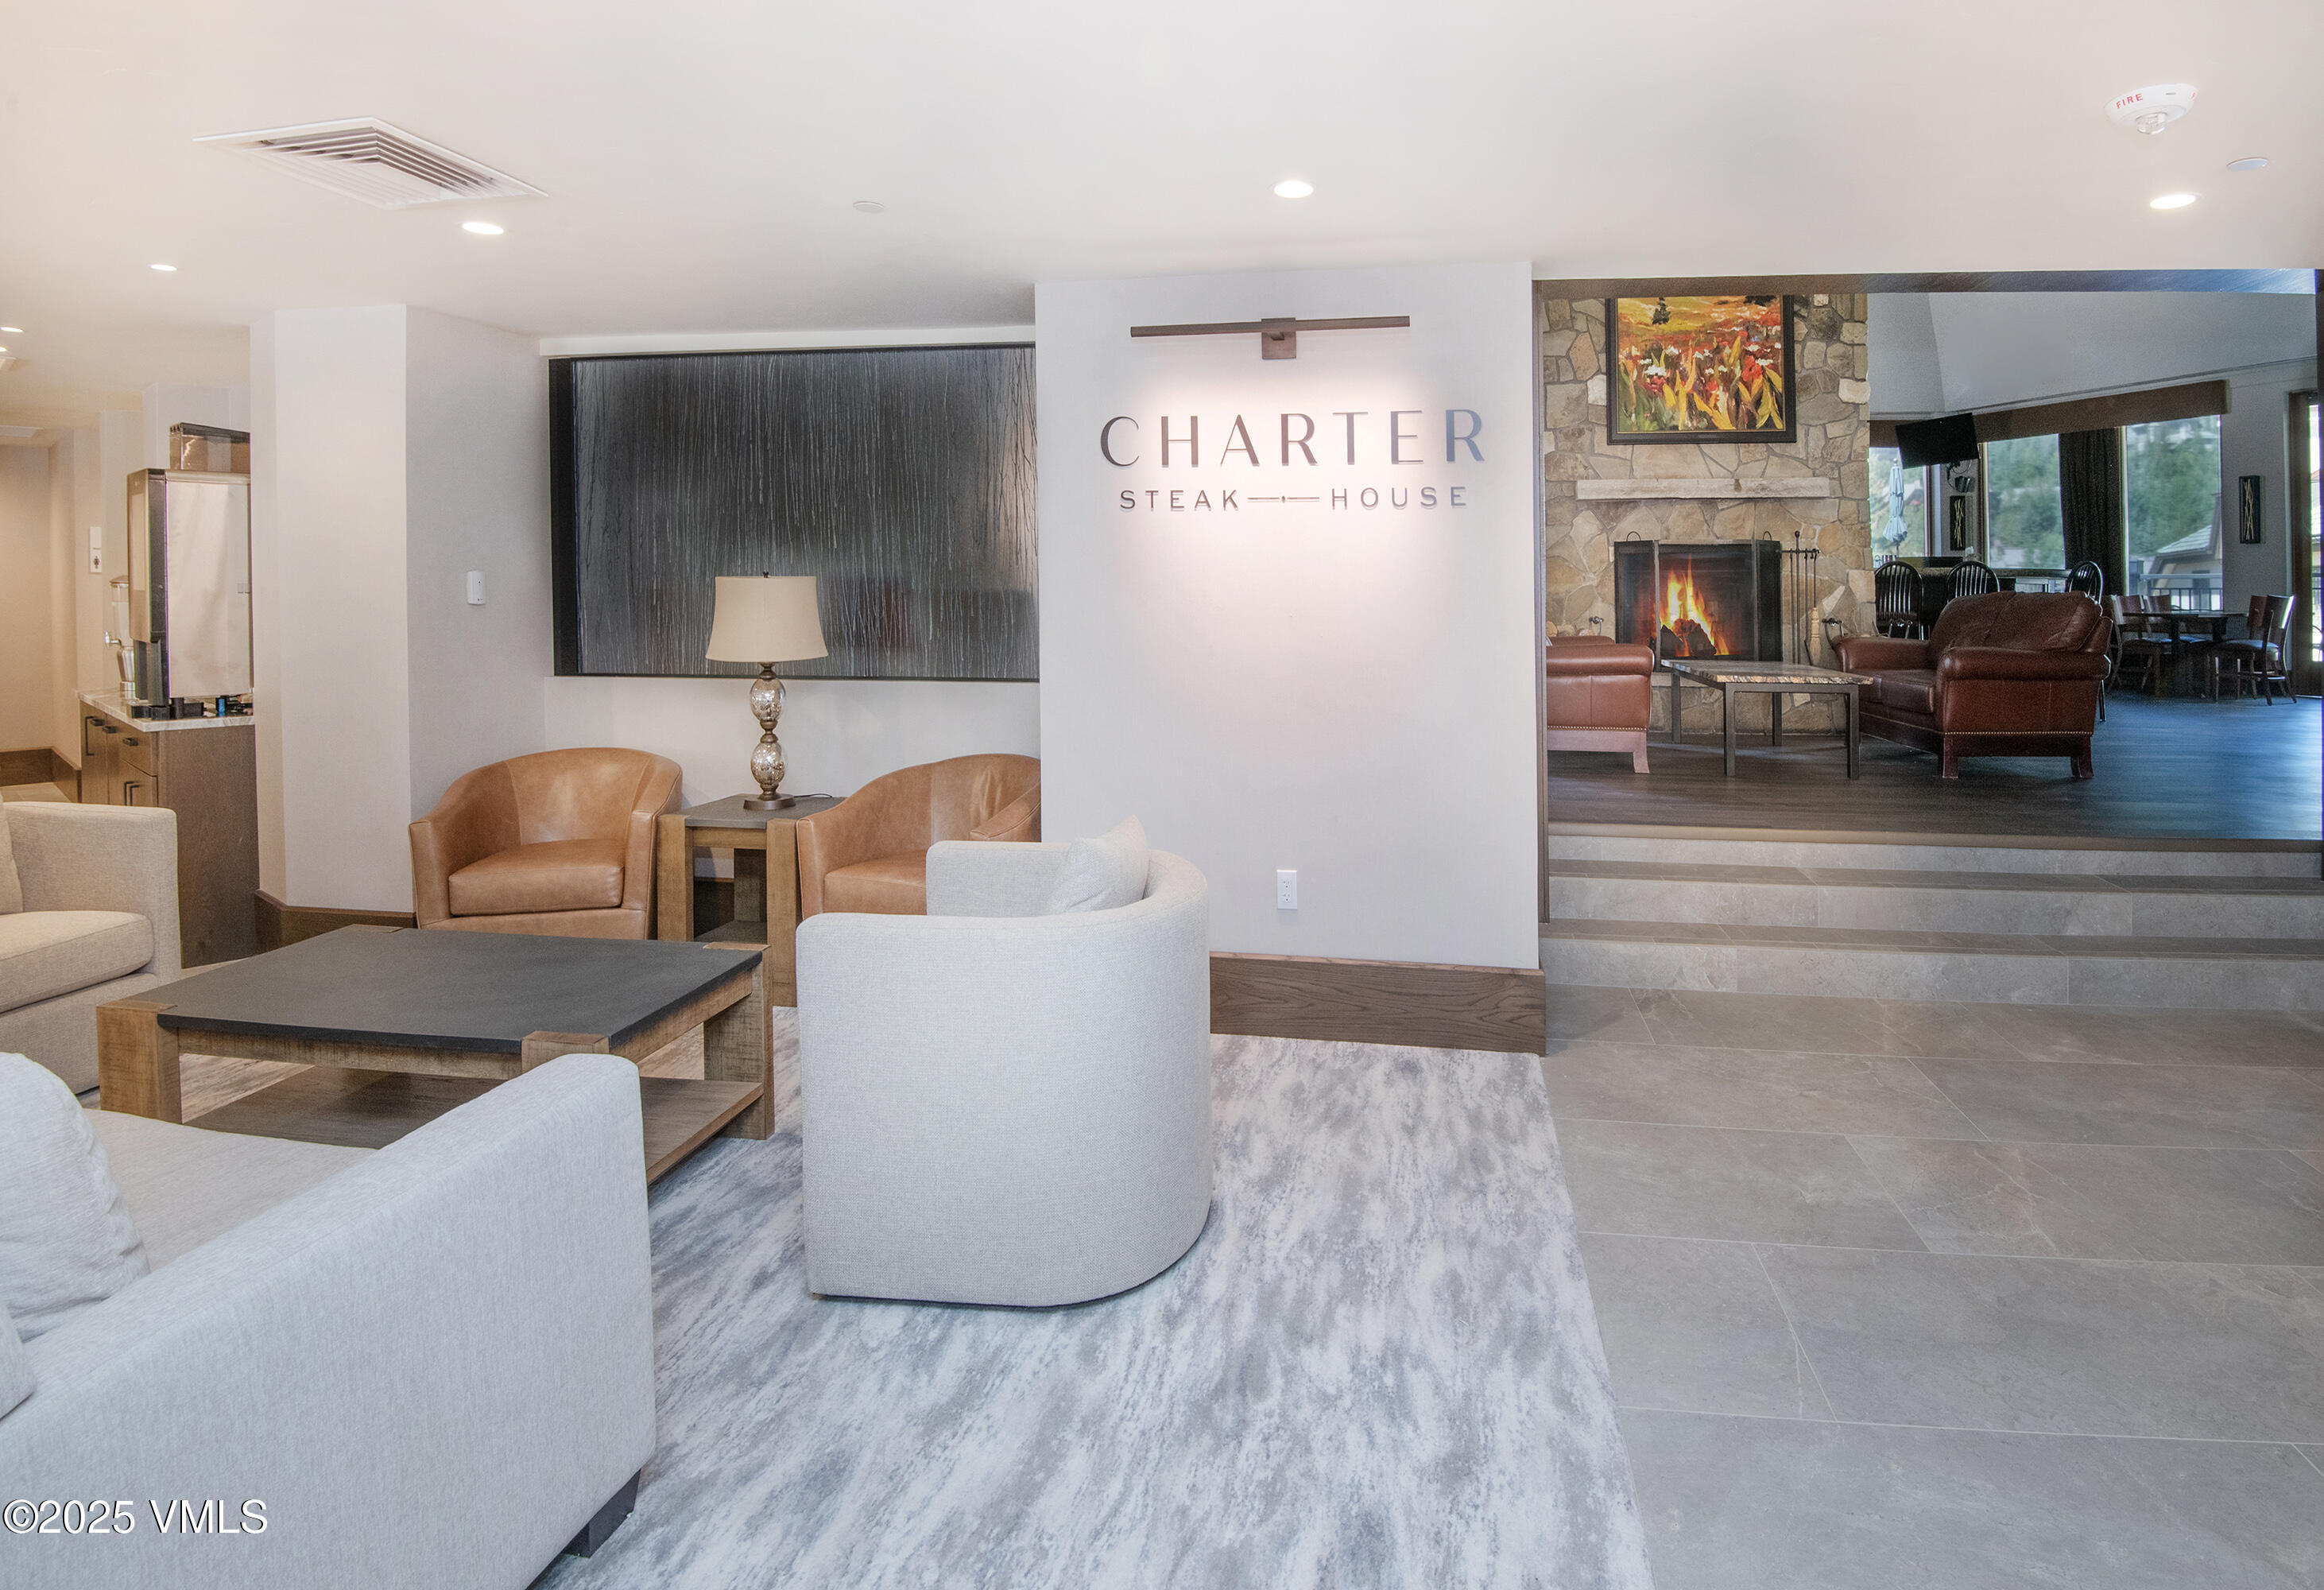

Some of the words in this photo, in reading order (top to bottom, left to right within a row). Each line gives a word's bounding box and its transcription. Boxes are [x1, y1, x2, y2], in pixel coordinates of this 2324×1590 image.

[2115, 93, 2144, 110] FIRE
[1100, 409, 1485, 467] CHARTER
[1120, 489, 1239, 511] STEAK
[1331, 486, 1466, 510] HOUSE
